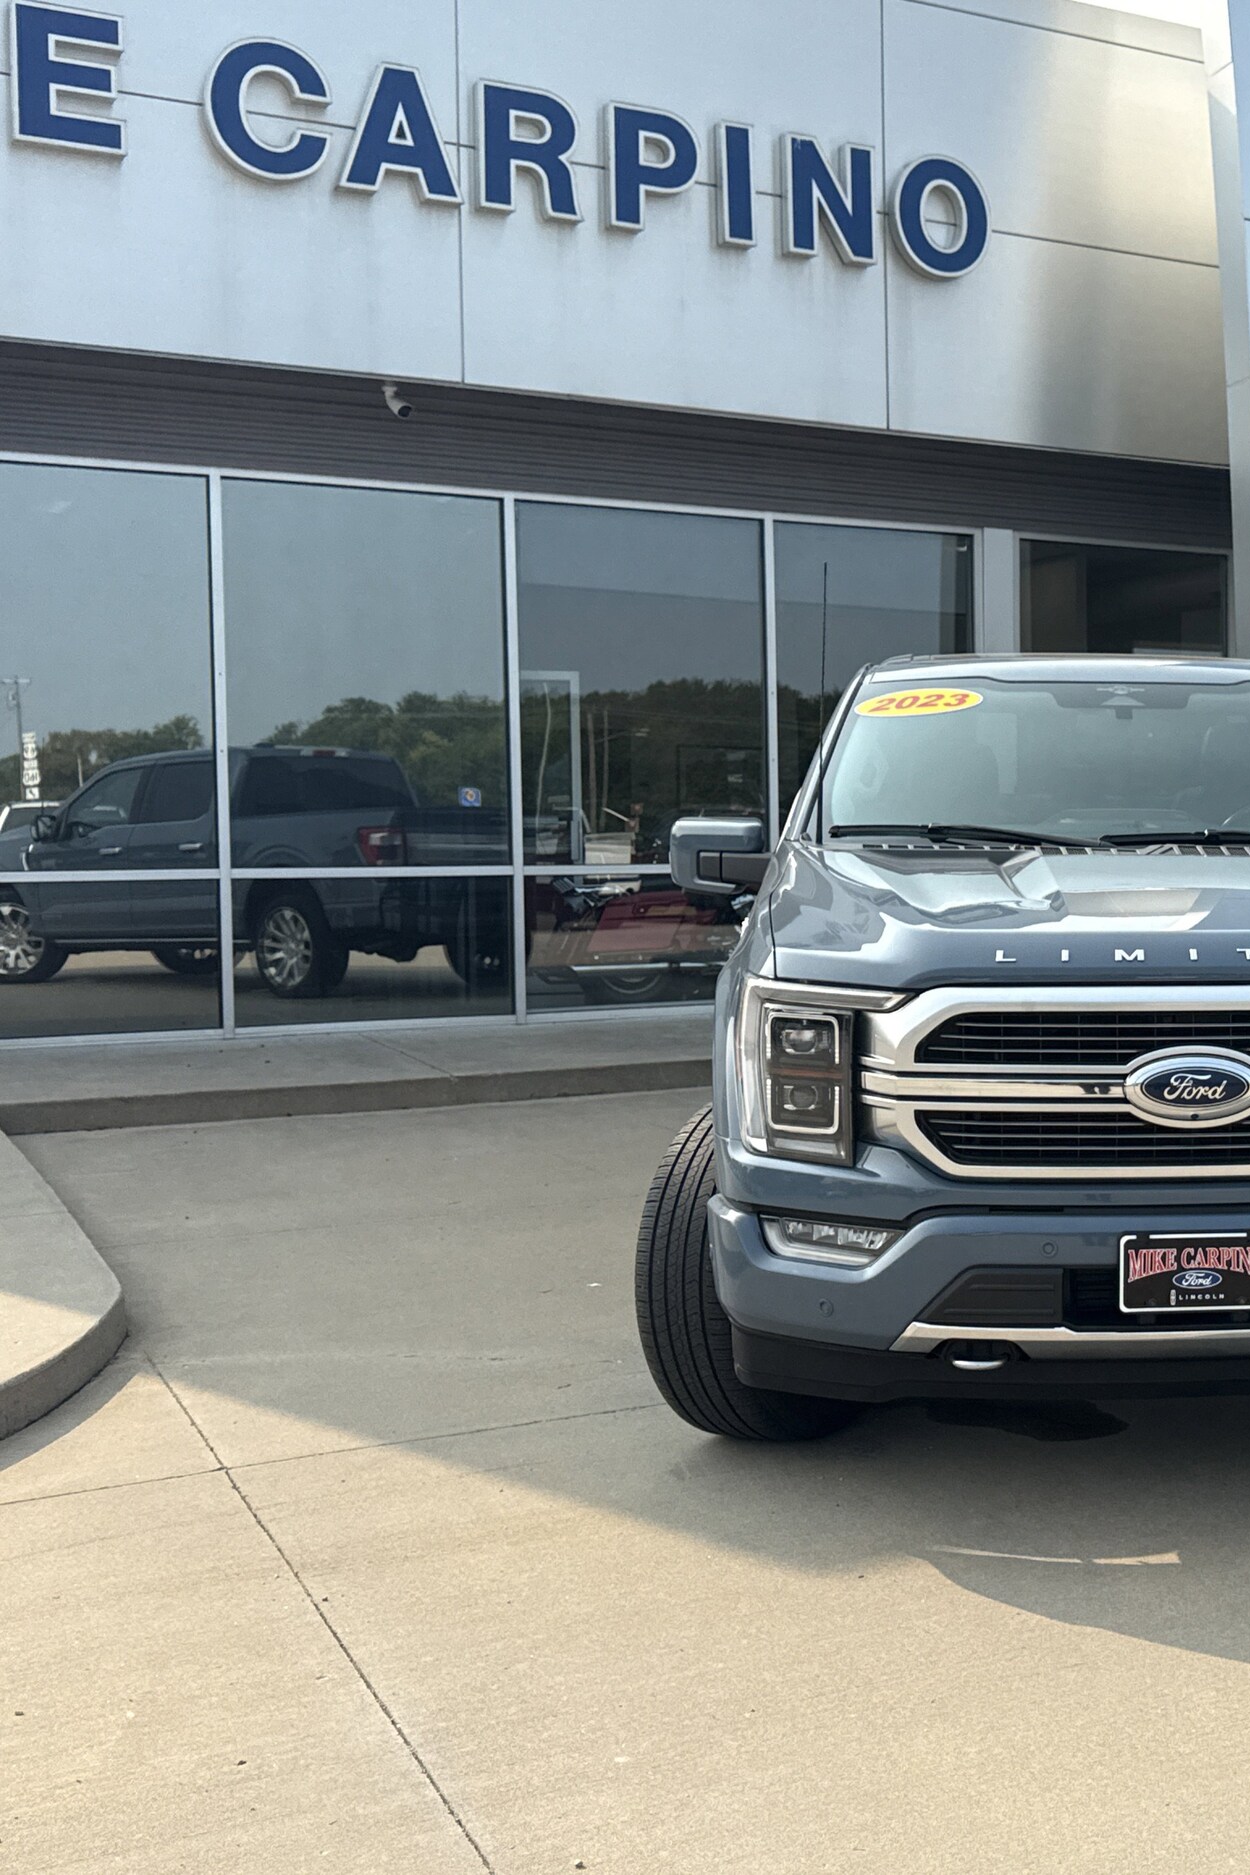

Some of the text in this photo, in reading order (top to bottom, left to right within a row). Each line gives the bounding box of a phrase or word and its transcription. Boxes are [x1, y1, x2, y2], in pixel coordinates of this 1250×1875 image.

[203, 36, 992, 280] CARPINO
[868, 693, 970, 713] 2023
[1163, 1073, 1228, 1100] Ford
[1127, 1247, 1178, 1283] MIKE
[1181, 1273, 1212, 1286] Ford
[1178, 1293, 1225, 1301] LINCOLN
